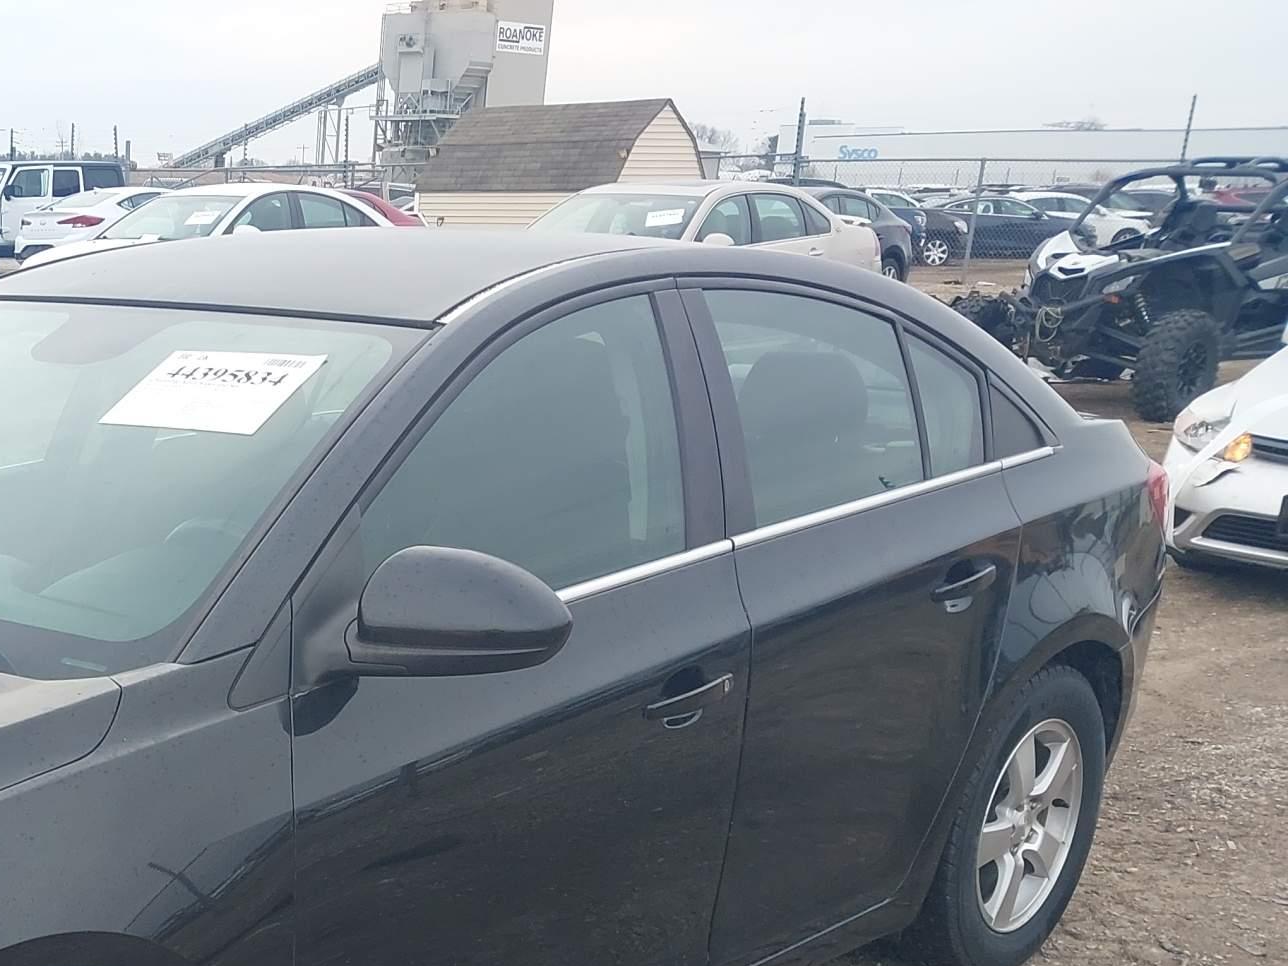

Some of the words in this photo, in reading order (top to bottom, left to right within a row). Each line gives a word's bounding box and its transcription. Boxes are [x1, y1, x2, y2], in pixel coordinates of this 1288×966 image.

[498, 26, 544, 43] ROANOKE
[838, 145, 878, 160] Sysco
[167, 365, 289, 387] 44395834
